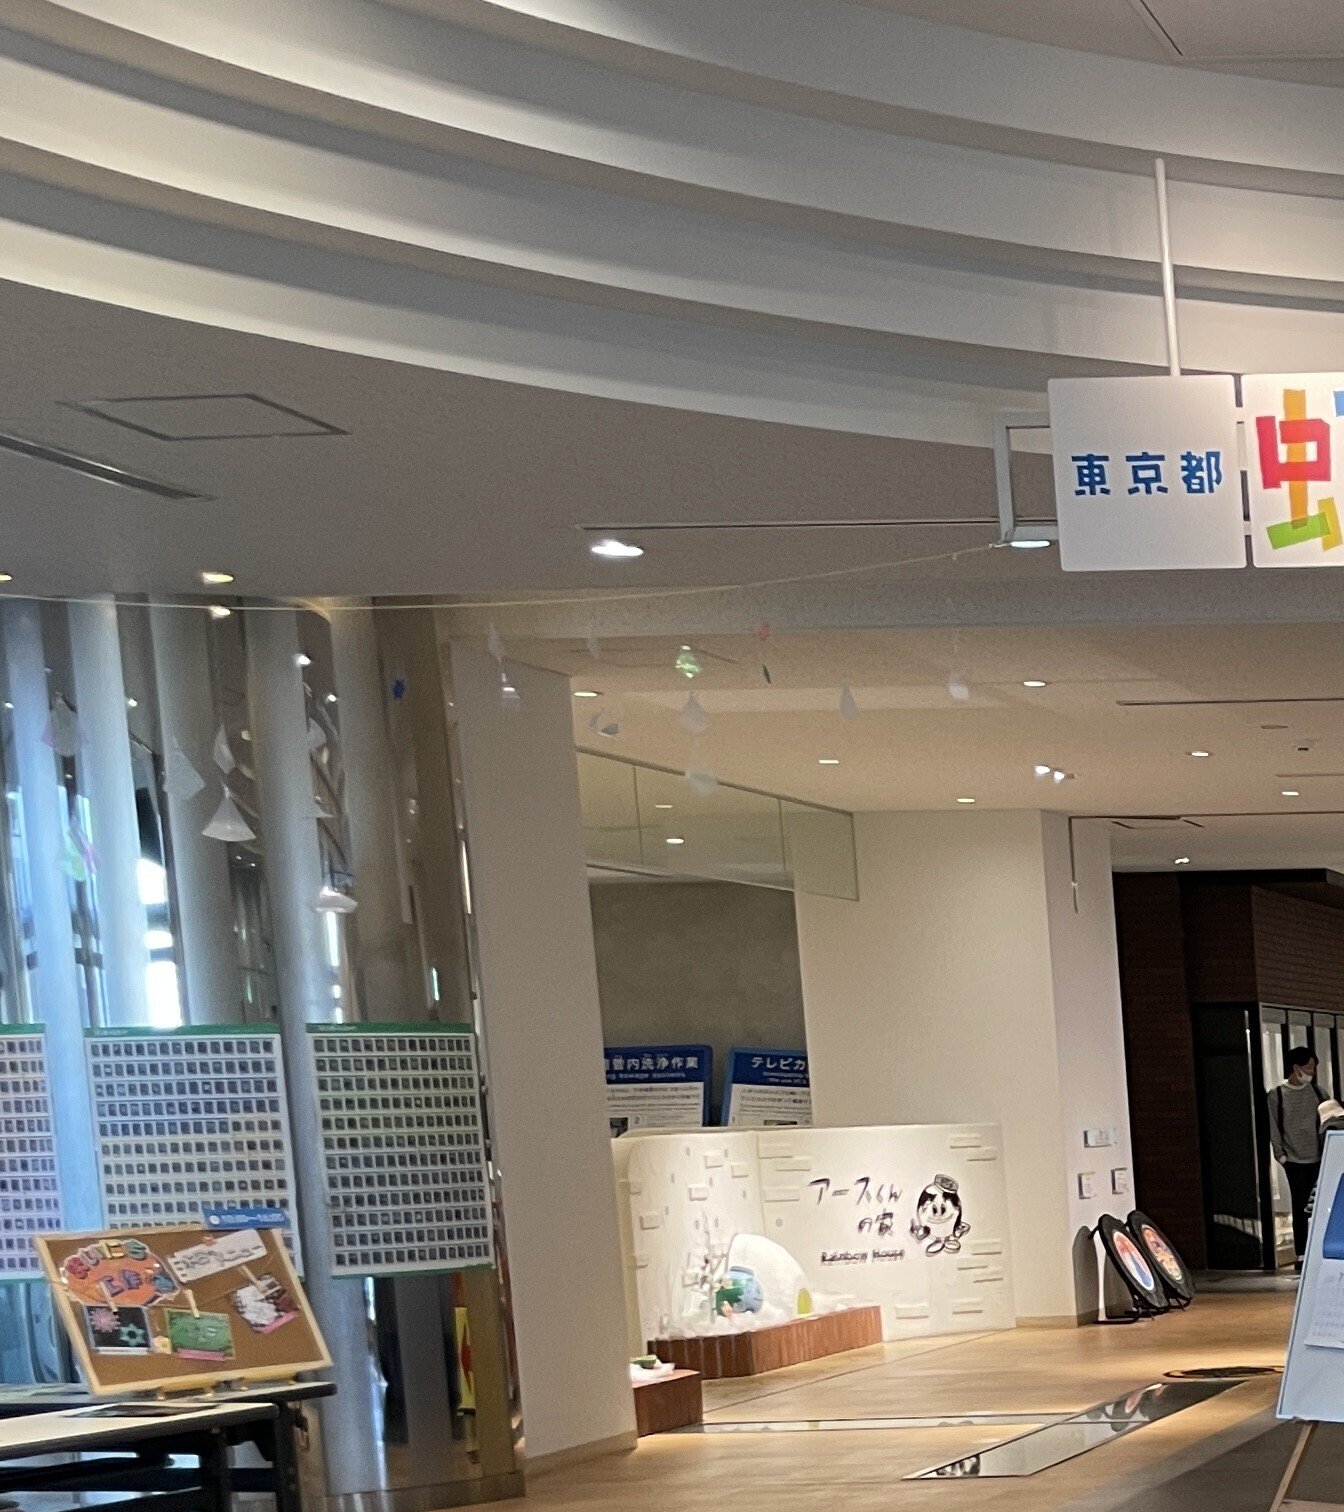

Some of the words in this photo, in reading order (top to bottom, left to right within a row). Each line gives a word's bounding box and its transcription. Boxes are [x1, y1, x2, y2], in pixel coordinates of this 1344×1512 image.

[1072, 451, 1222, 496] 東京都
[807, 1176, 904, 1206] アースくん
